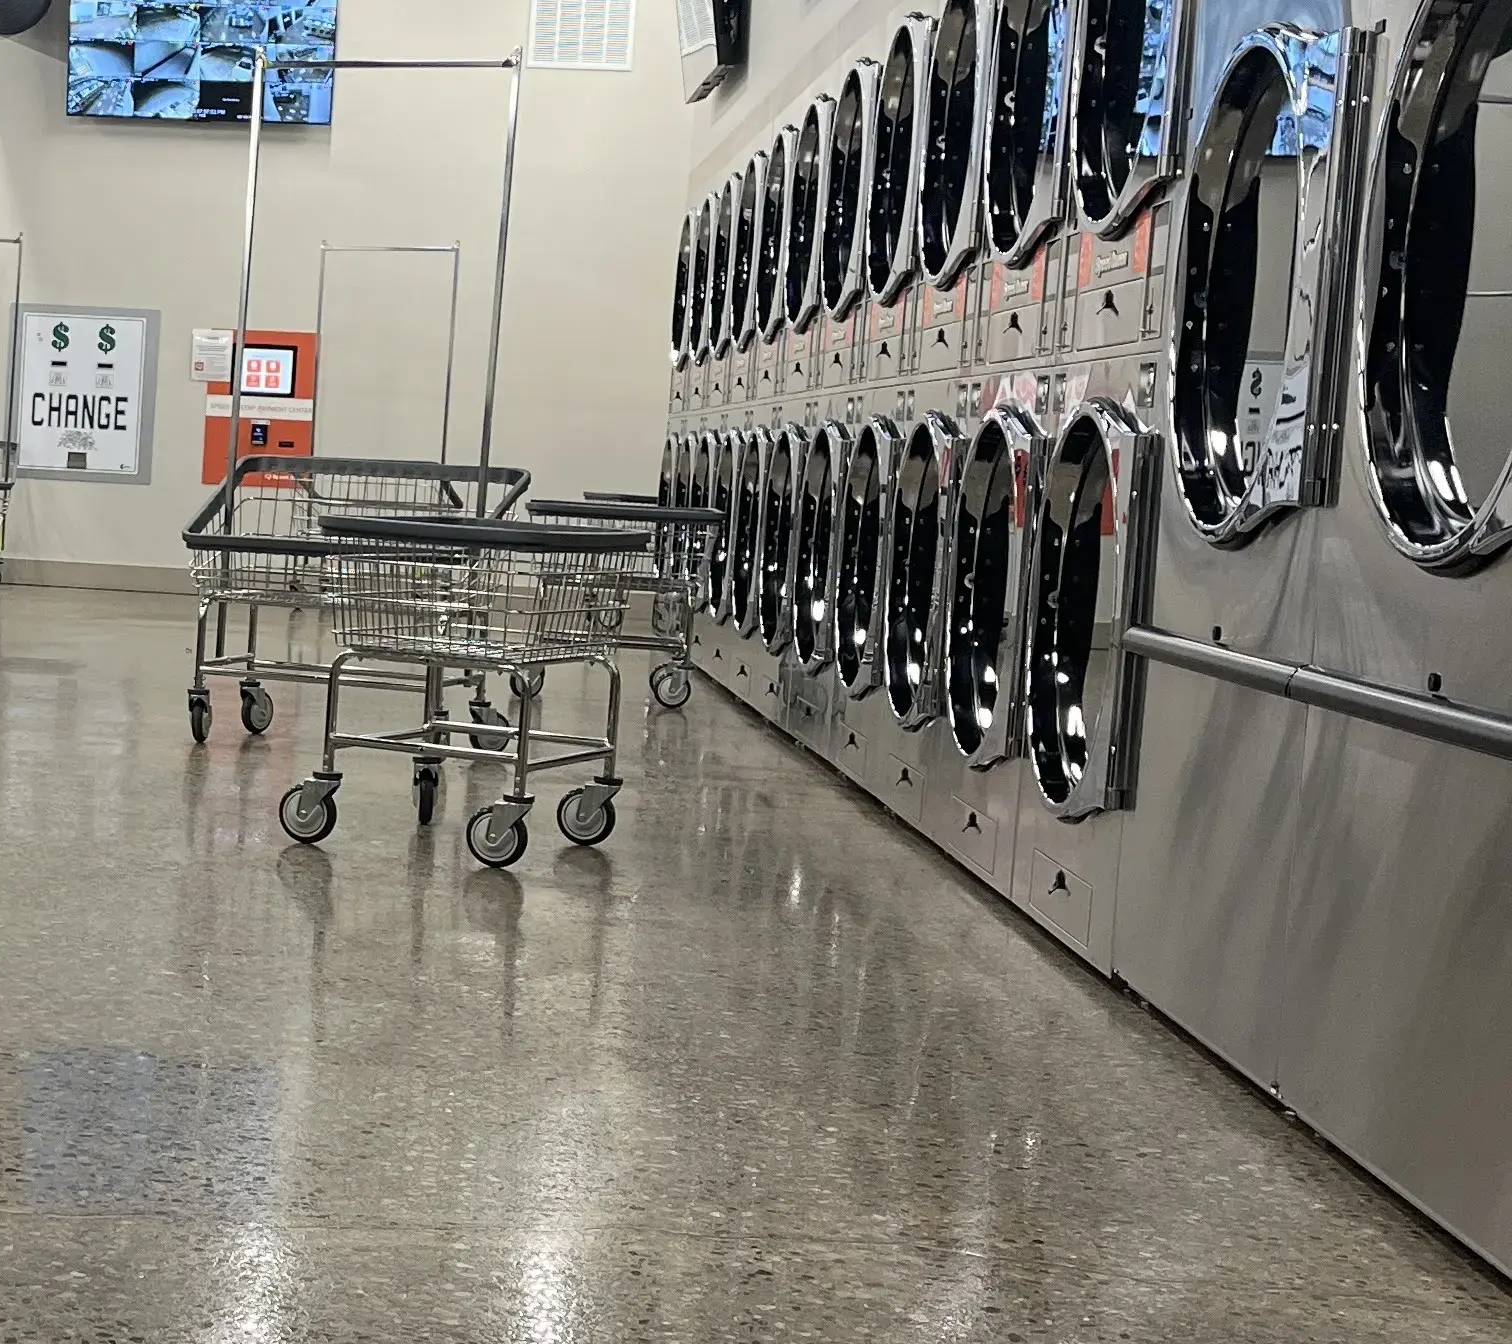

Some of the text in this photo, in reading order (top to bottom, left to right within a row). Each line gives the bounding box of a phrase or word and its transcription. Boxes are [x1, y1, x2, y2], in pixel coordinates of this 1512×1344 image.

[51, 321, 116, 355] $ $
[31, 392, 129, 431] CHANGE
[256, 405, 288, 414] PAYMENT
[287, 406, 313, 415] CENTER
